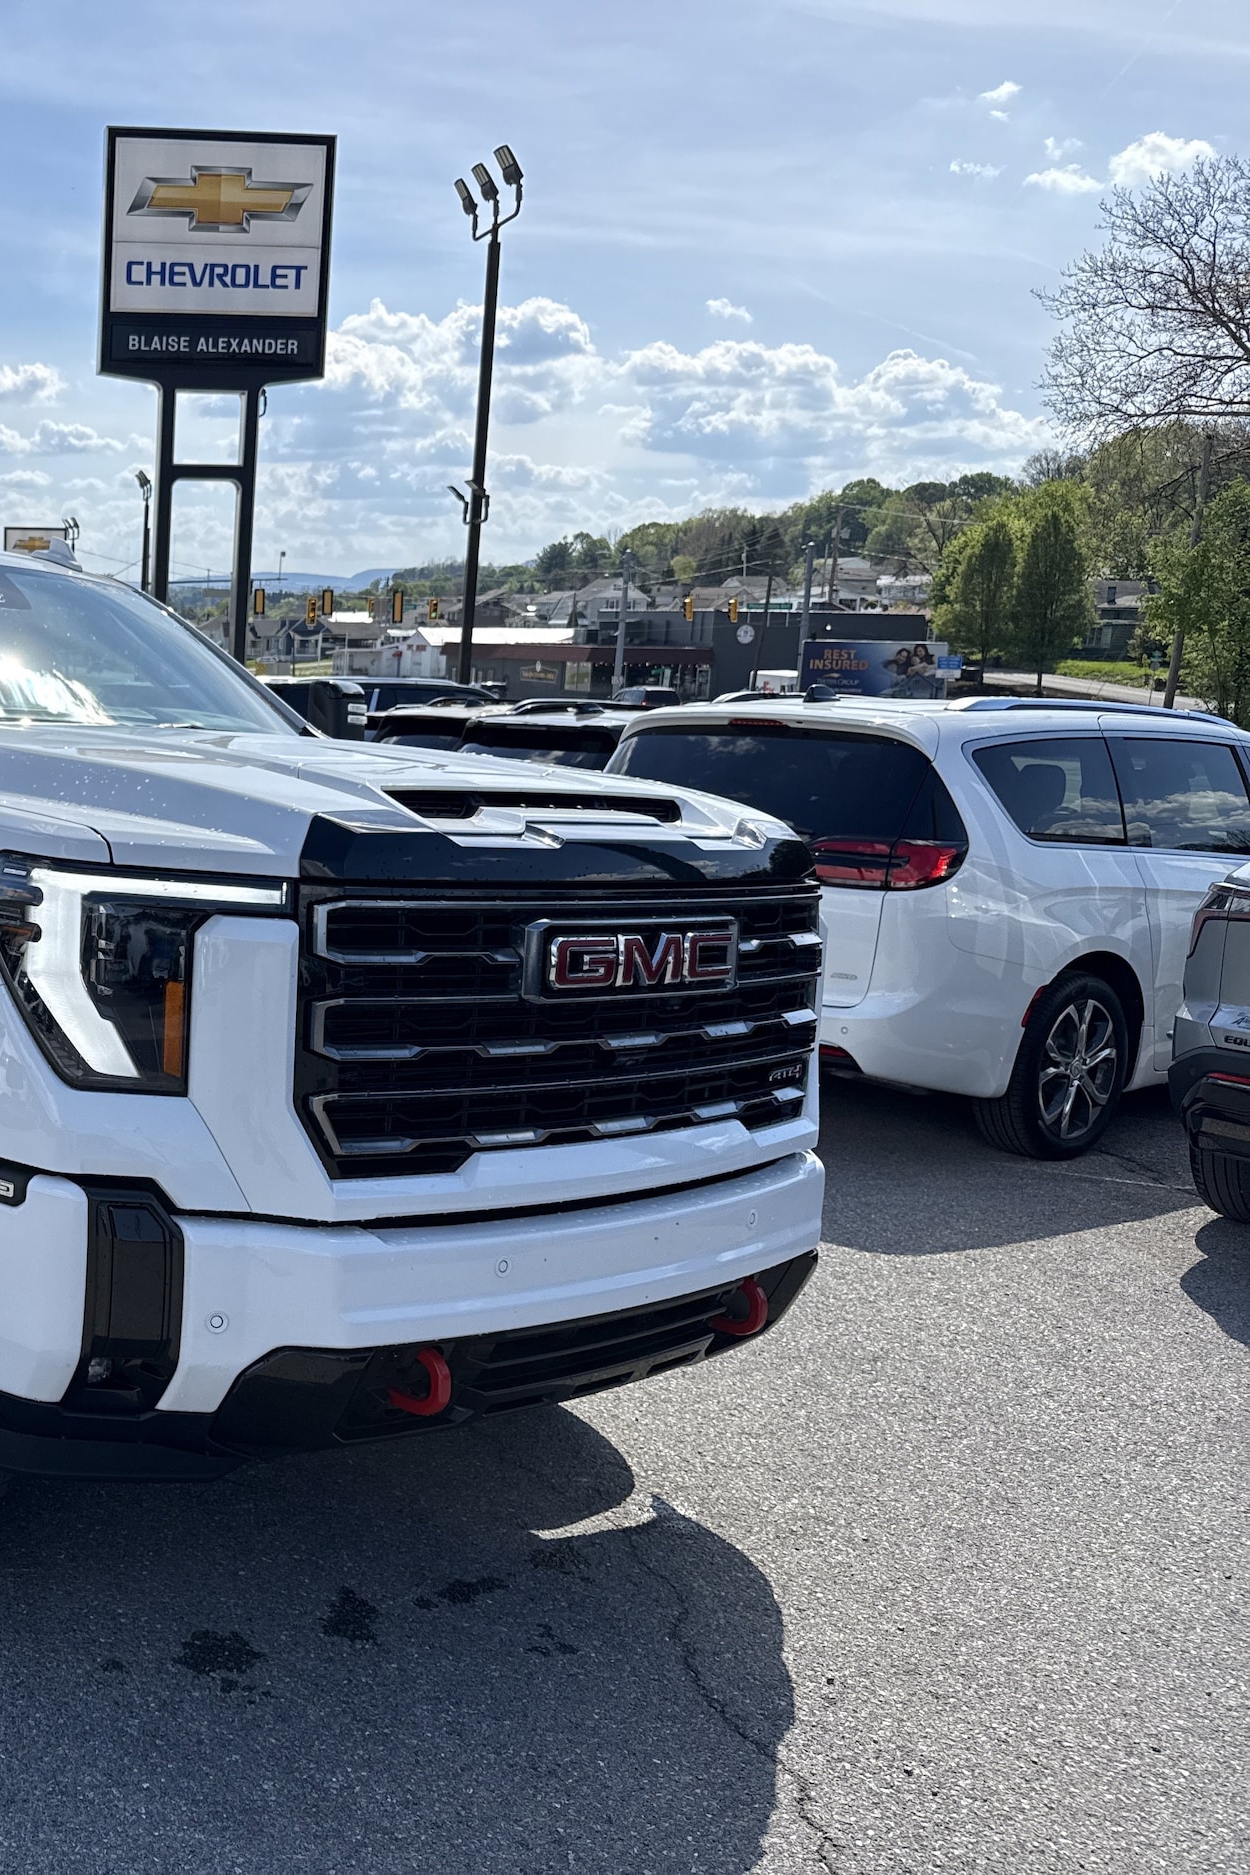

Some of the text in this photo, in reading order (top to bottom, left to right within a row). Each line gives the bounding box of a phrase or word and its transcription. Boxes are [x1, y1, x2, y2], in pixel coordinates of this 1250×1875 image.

[126, 261, 308, 290] CHEVROLET
[128, 335, 299, 355] BLAISE ALEXANDER
[823, 649, 857, 660] REST
[809, 658, 870, 671] INSURED
[549, 931, 734, 990] GMC
[769, 1064, 803, 1082] AT4
